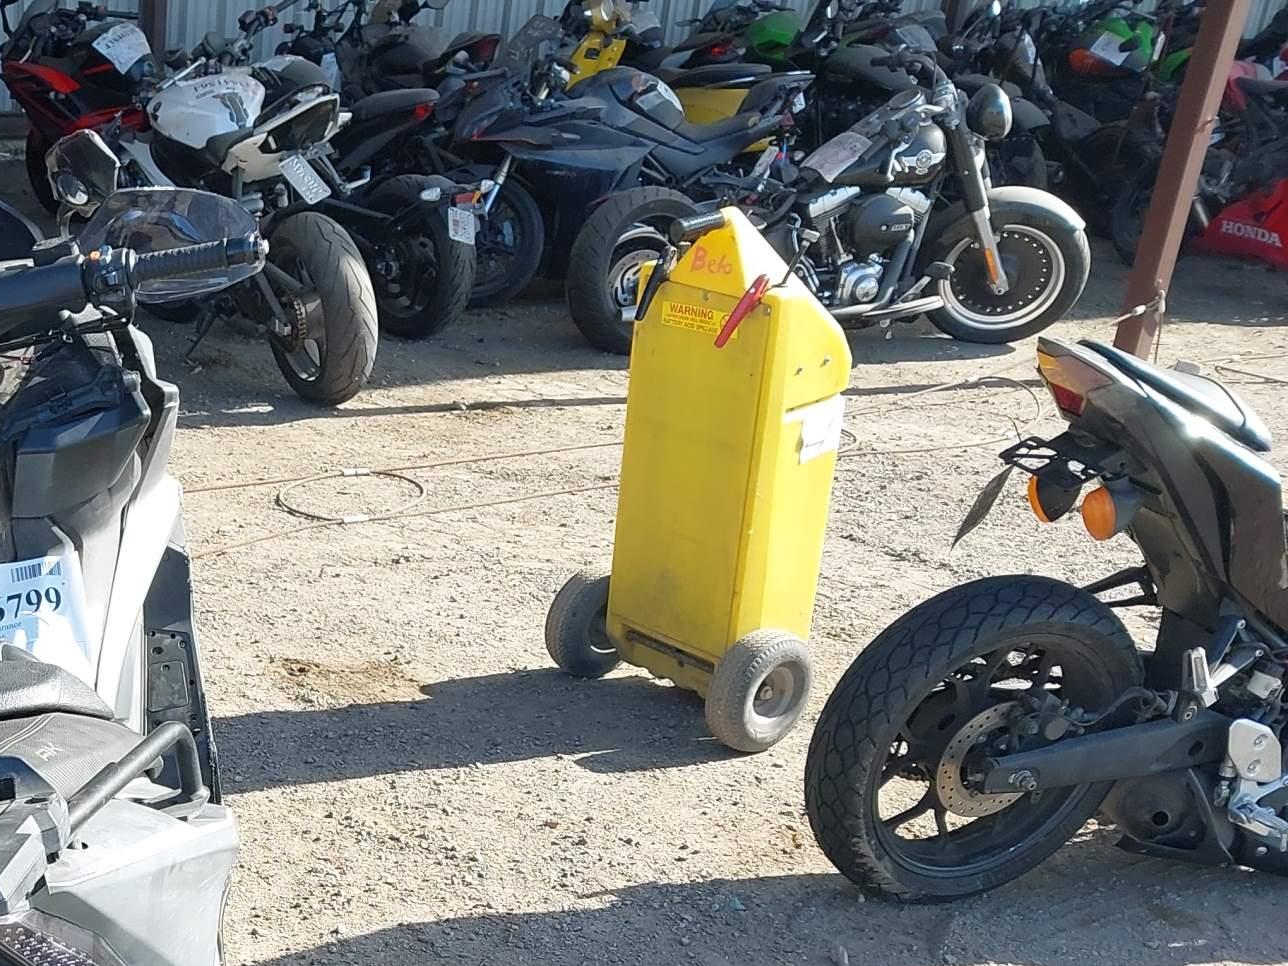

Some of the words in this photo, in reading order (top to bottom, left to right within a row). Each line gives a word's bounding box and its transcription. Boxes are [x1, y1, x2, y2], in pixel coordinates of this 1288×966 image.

[1221, 220, 1283, 247] HONDA
[670, 303, 714, 320] WARNING
[34, 742, 65, 762] AK
